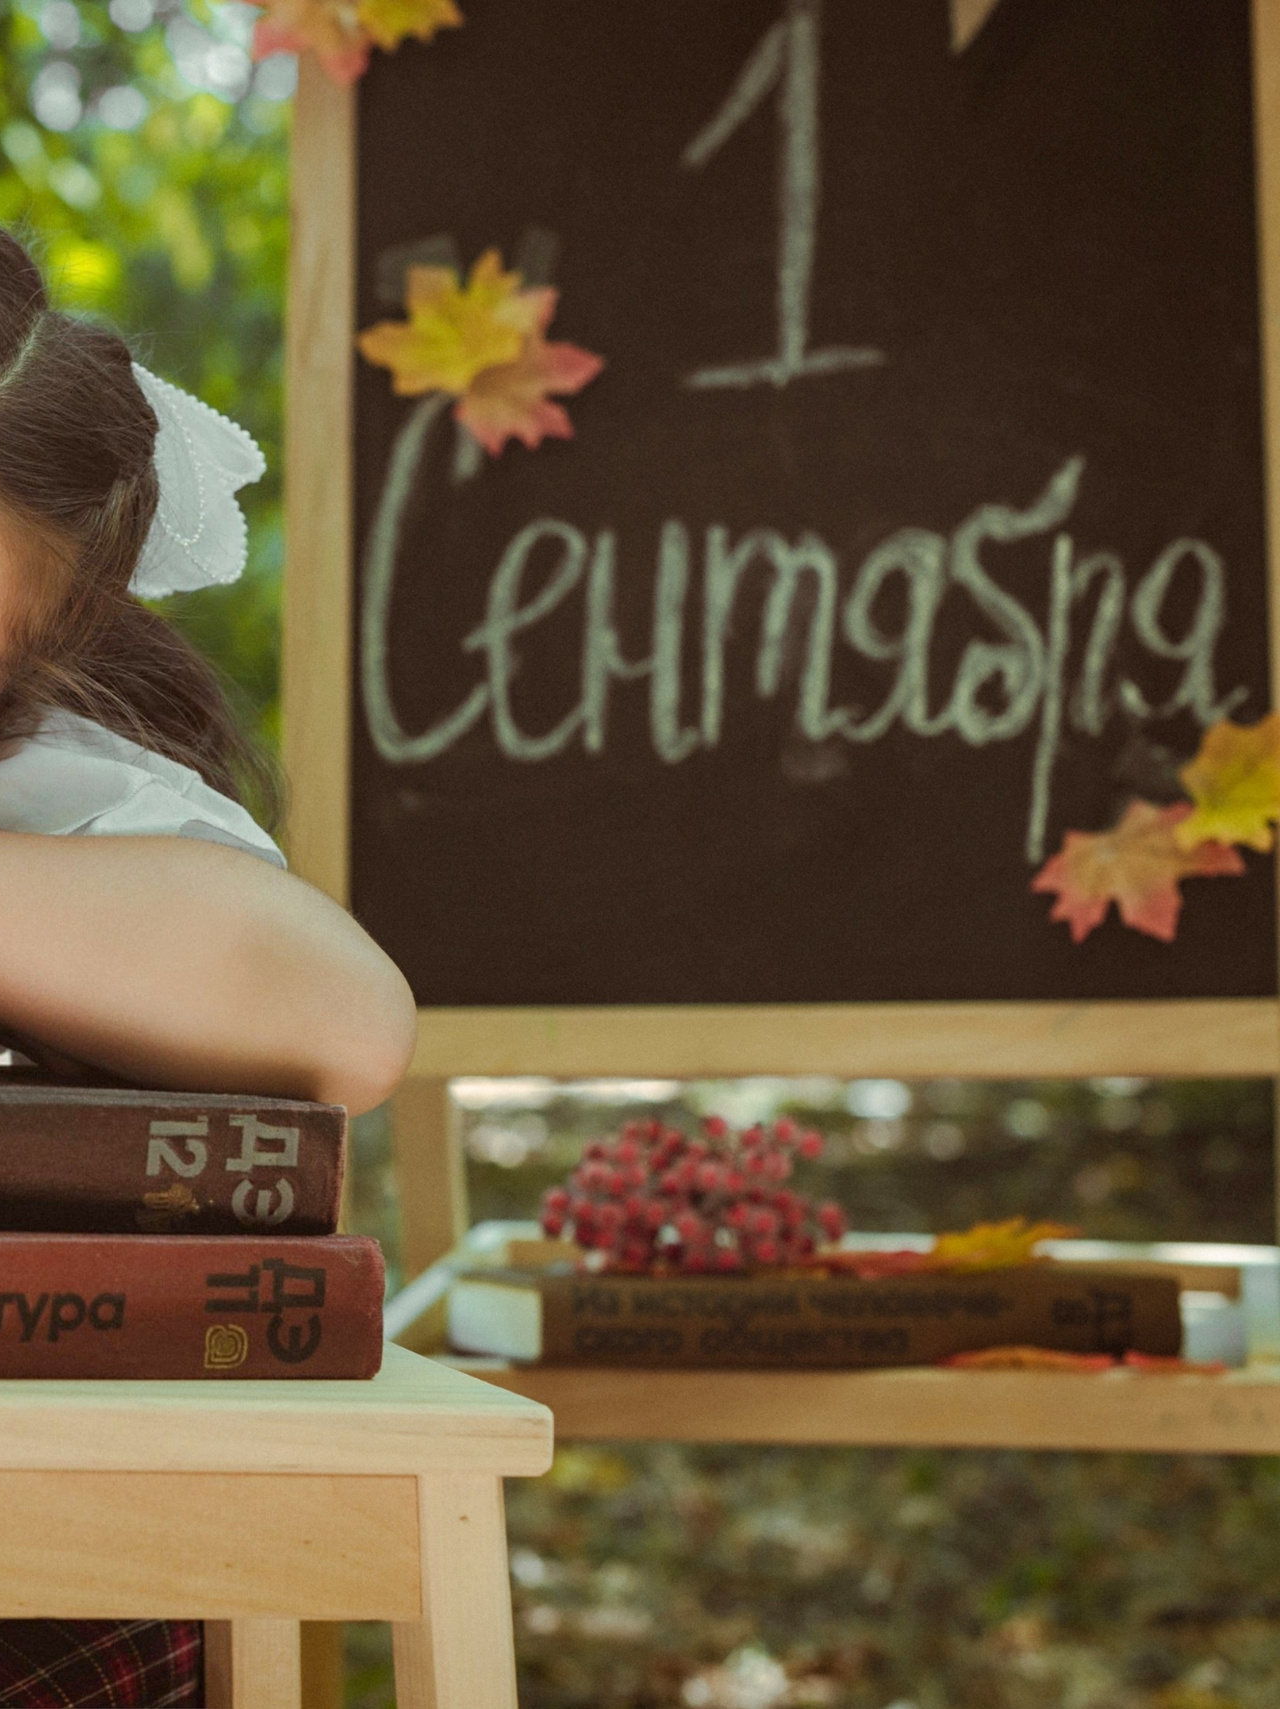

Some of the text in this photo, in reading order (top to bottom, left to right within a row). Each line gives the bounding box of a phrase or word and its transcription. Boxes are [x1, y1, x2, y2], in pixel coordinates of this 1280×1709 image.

[682, 4, 886, 387] 1
[362, 390, 1250, 864] Сентября
[146, 1115, 208, 1178] 12
[225, 1114, 300, 1226] ДЭ
[204, 1264, 260, 1313] 11
[261, 1258, 327, 1363] ДЭ
